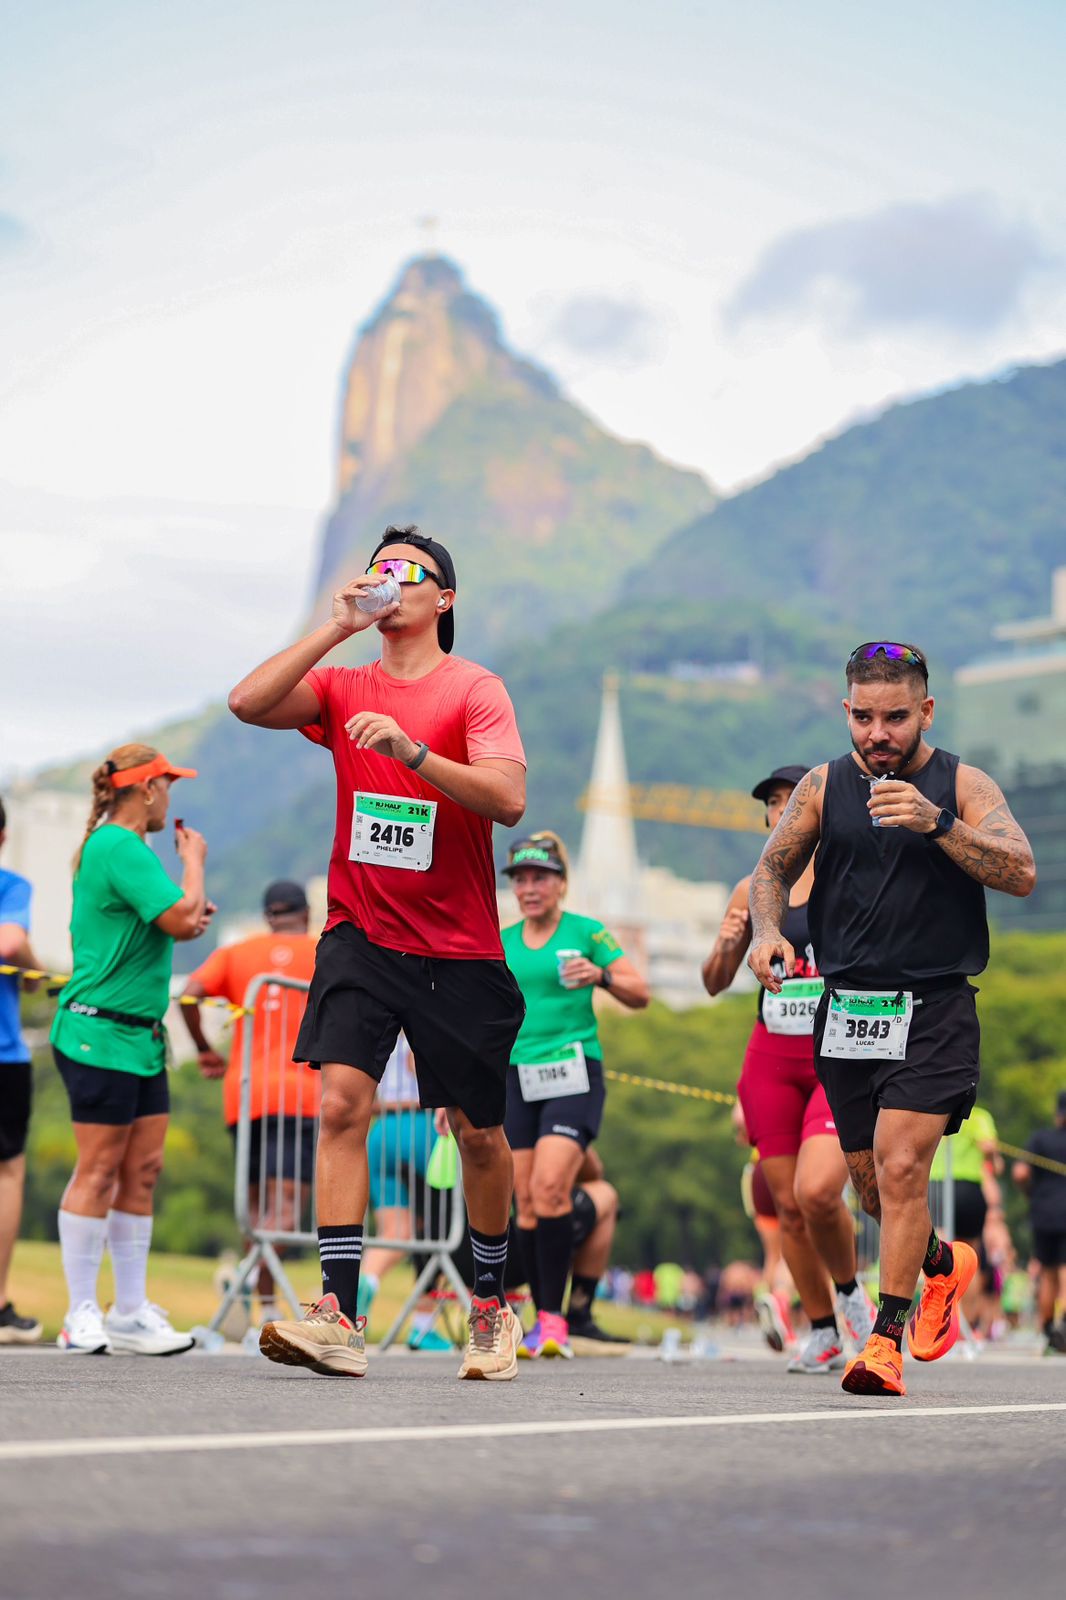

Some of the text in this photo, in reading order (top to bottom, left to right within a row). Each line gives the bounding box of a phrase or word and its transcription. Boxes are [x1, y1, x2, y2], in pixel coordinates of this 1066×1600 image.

[408, 807, 428, 817] 21K
[421, 824, 427, 832] C
[370, 822, 415, 847] 2416
[376, 845, 403, 853] PHELIPE
[780, 1002, 817, 1017] 3026
[845, 1018, 891, 1039] 3843
